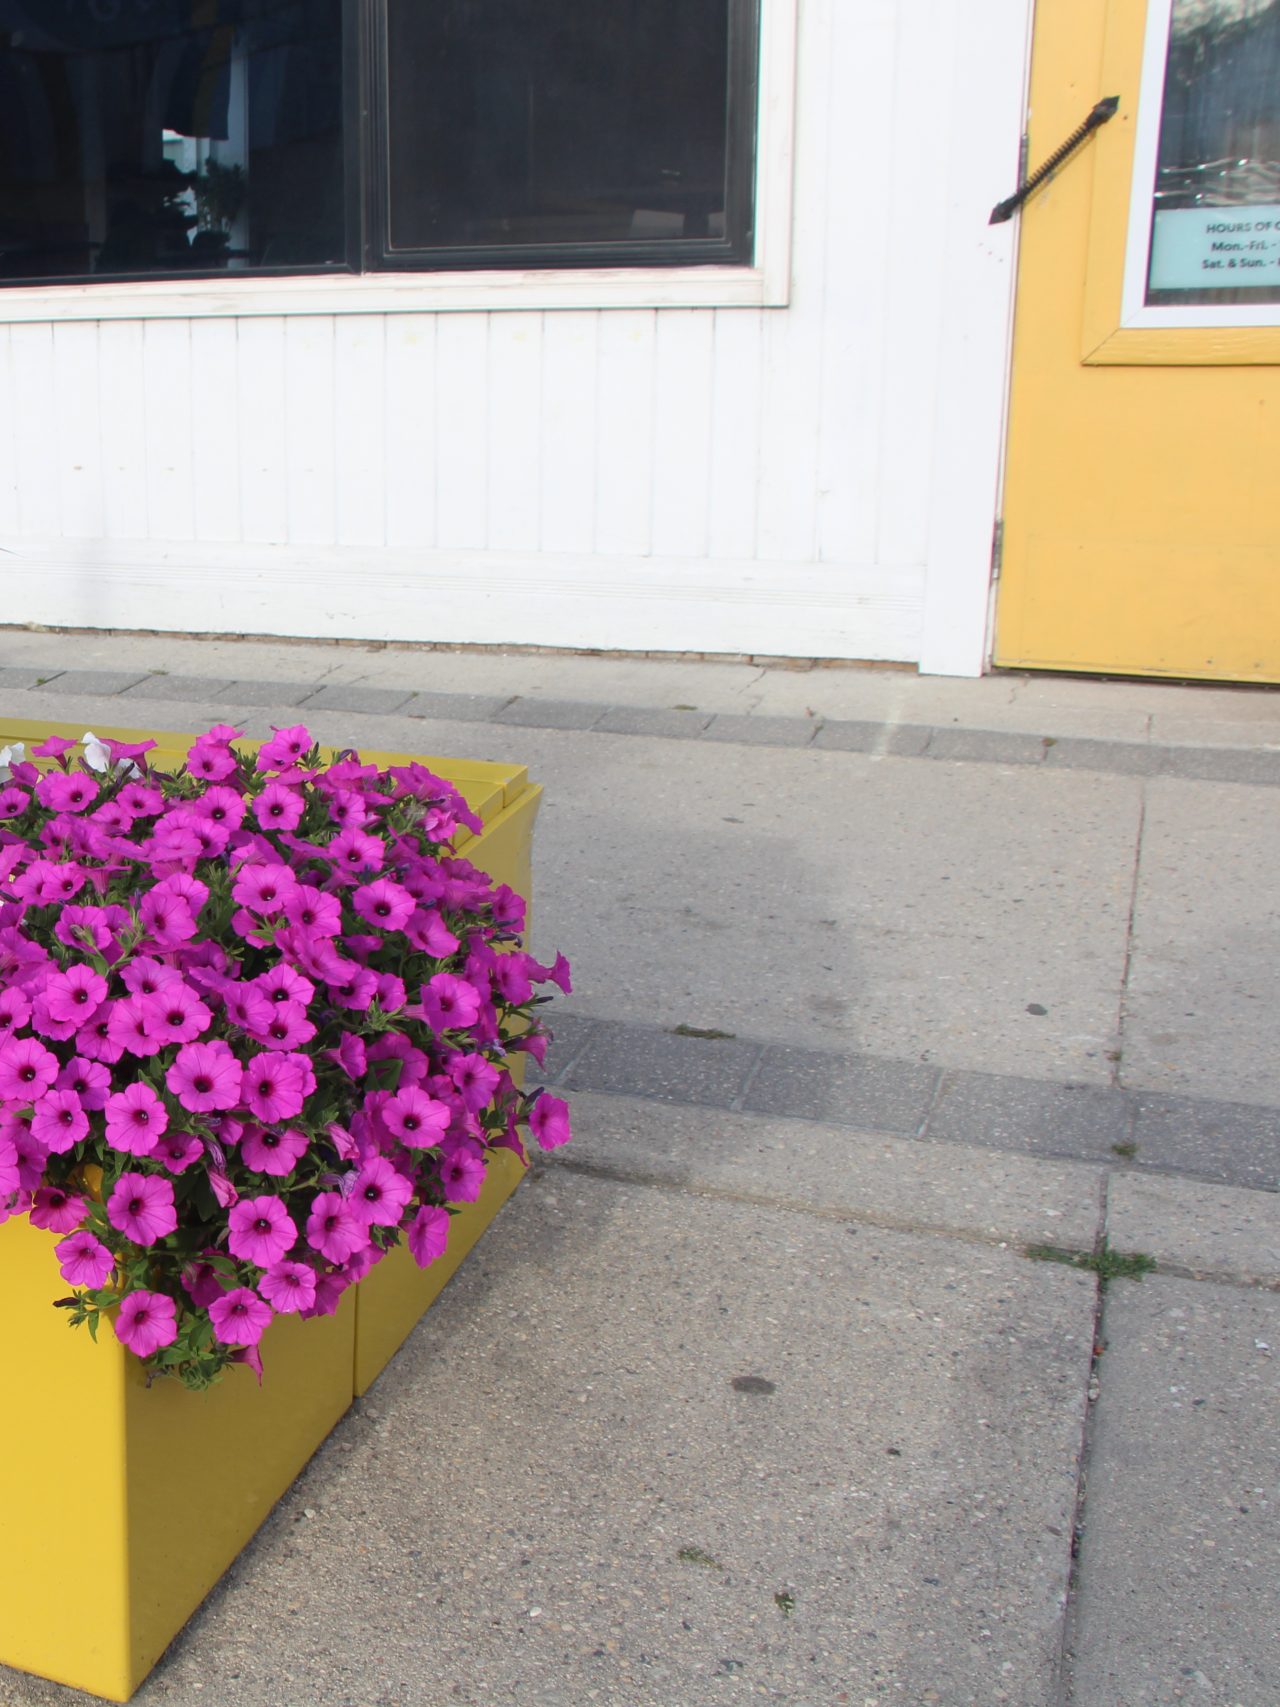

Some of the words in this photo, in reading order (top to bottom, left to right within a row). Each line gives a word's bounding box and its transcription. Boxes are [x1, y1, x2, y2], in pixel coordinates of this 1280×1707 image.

[1206, 222, 1252, 234] HOURS
[1254, 220, 1272, 232] OF
[1202, 258, 1225, 269] Sat.
[1228, 258, 1237, 268] &
[1239, 257, 1267, 268] Sun.
